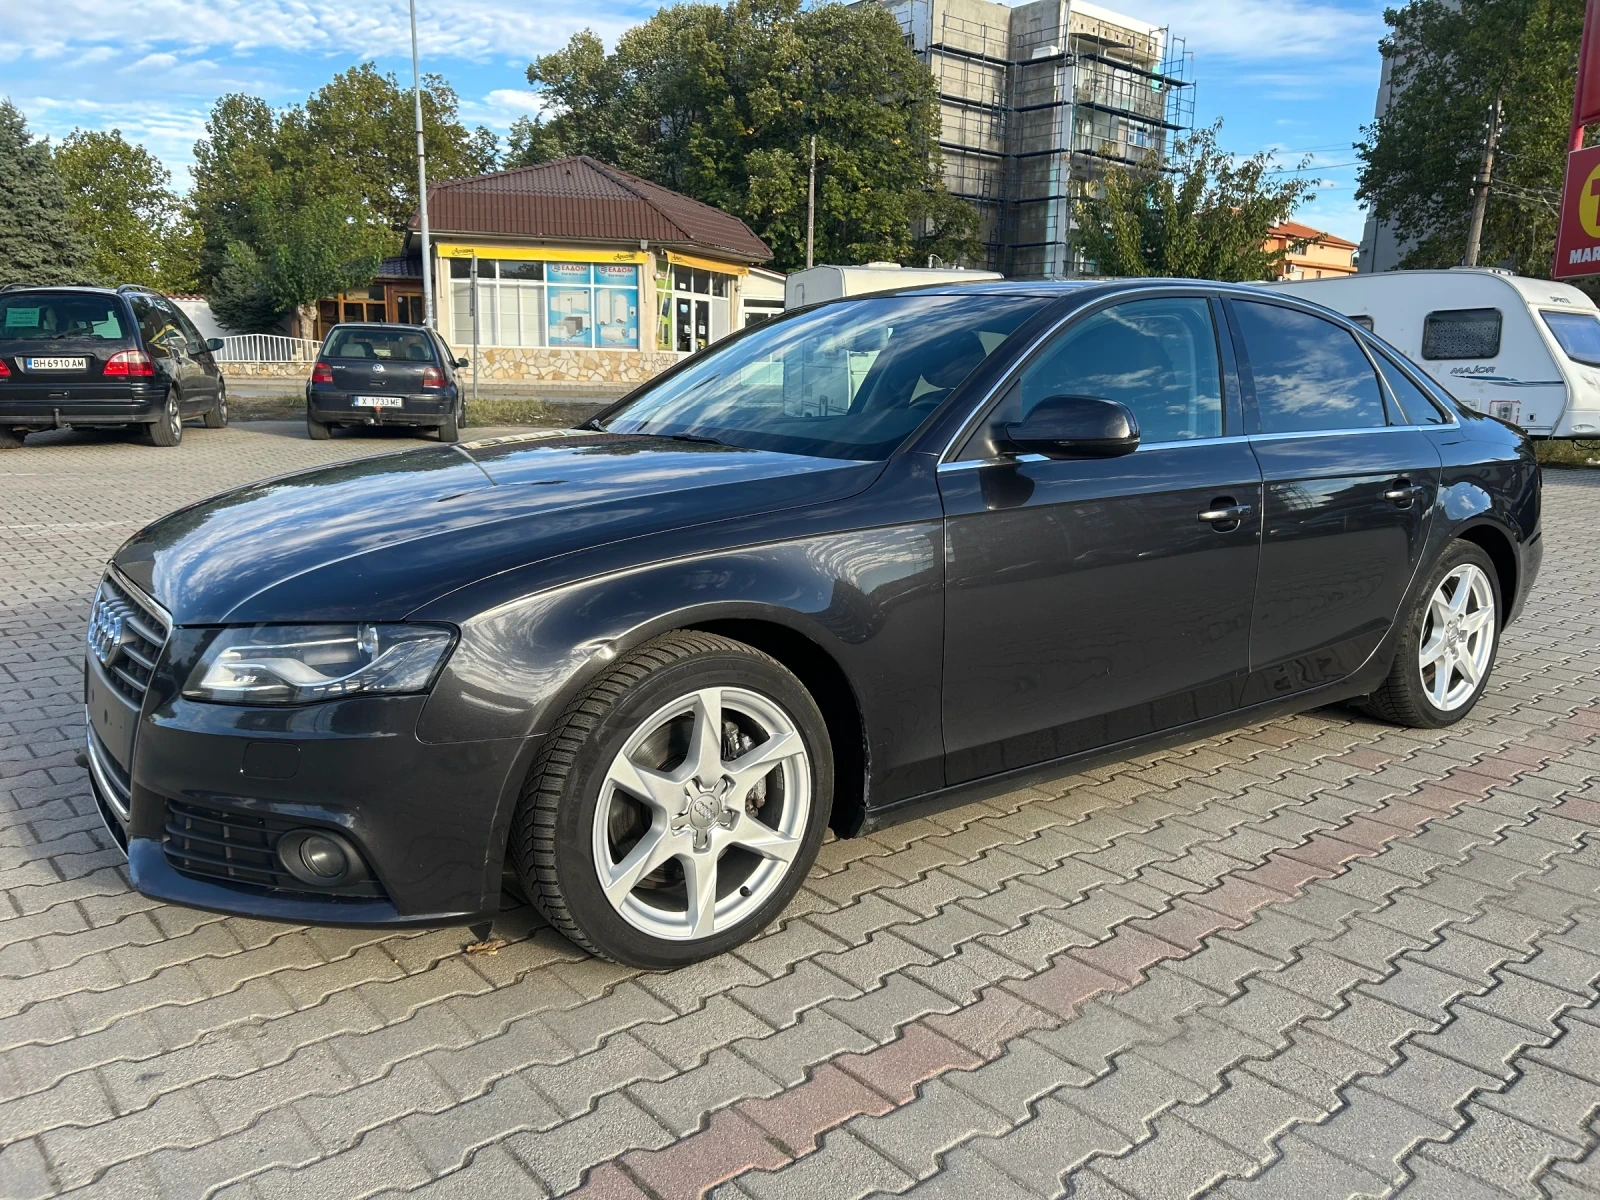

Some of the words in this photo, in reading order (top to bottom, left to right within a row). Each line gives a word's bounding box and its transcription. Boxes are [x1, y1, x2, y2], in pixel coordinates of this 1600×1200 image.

[33, 360, 46, 368] BH
[47, 360, 70, 368] 6910
[72, 360, 84, 368] AM
